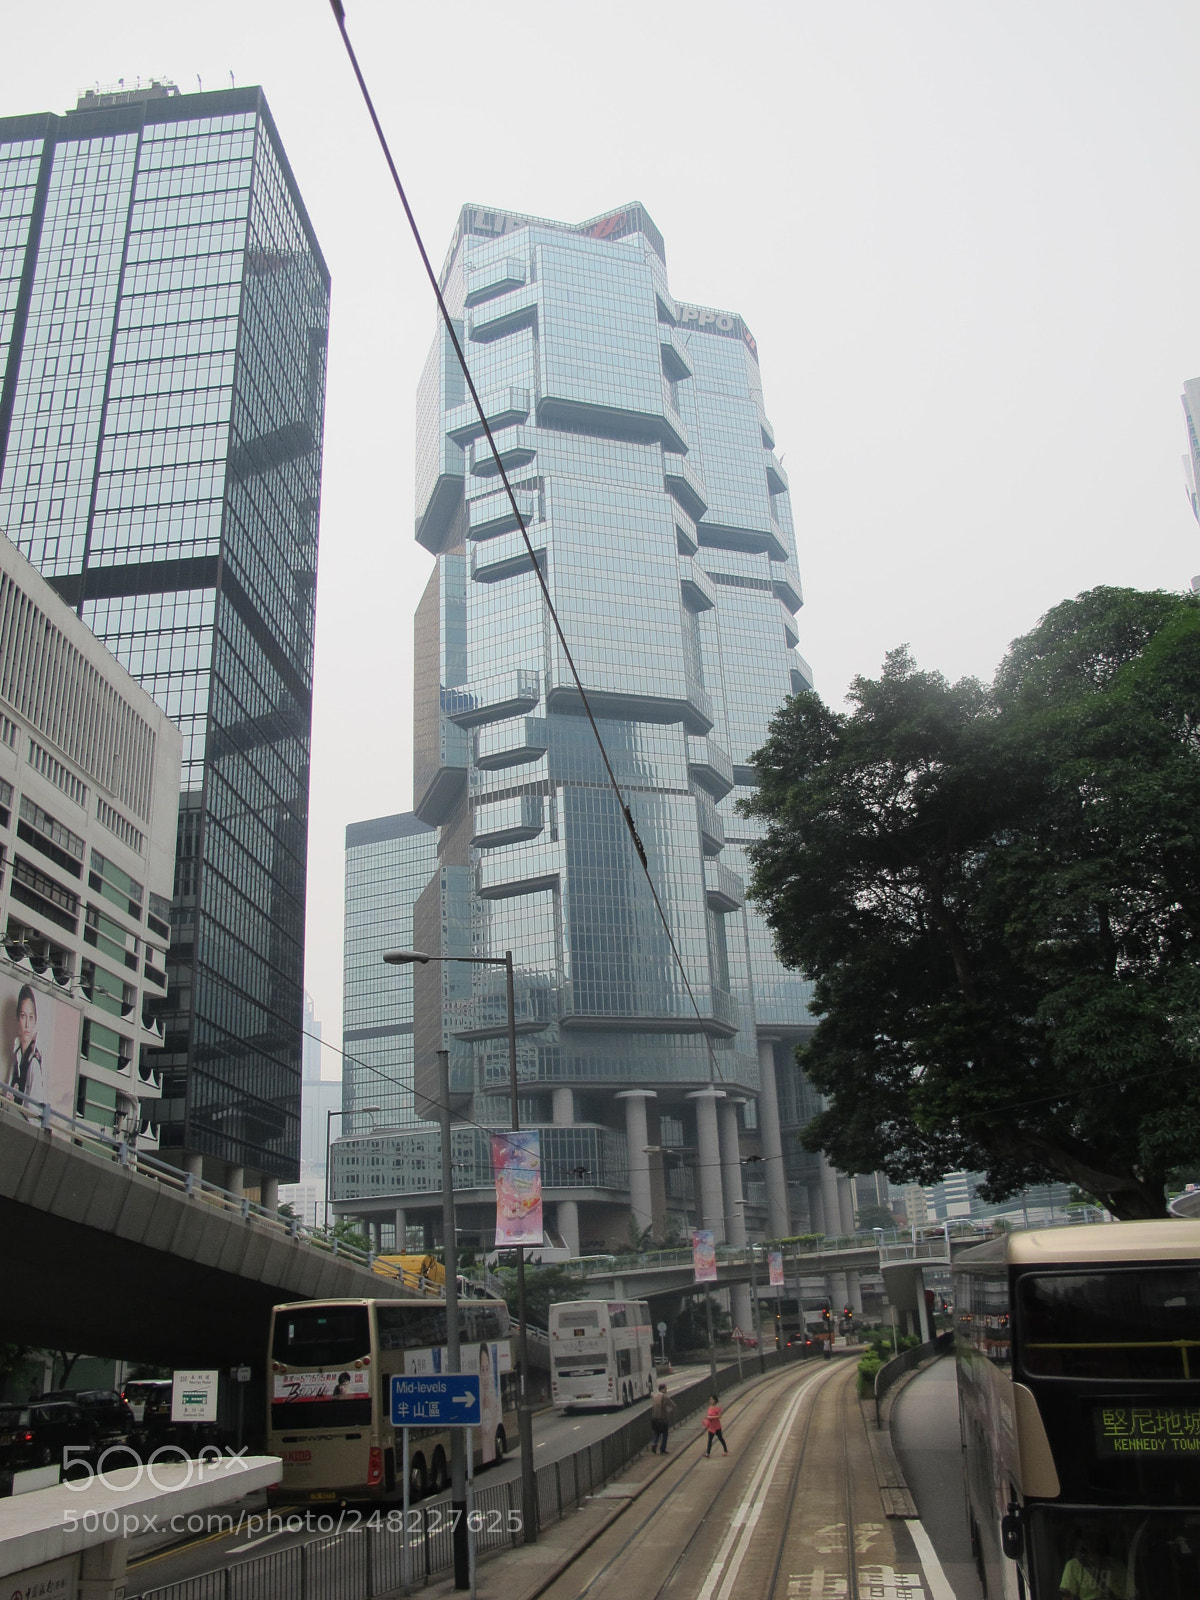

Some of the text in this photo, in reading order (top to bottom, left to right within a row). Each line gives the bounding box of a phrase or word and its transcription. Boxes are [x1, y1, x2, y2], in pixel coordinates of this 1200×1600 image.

[676, 307, 734, 331] IPPO
[396, 1381, 447, 1394] Mid-levels
[397, 1401, 441, 1418] 半山區
[1114, 1438, 1166, 1451] KENNEDY
[288, 1450, 312, 1461] KMB
